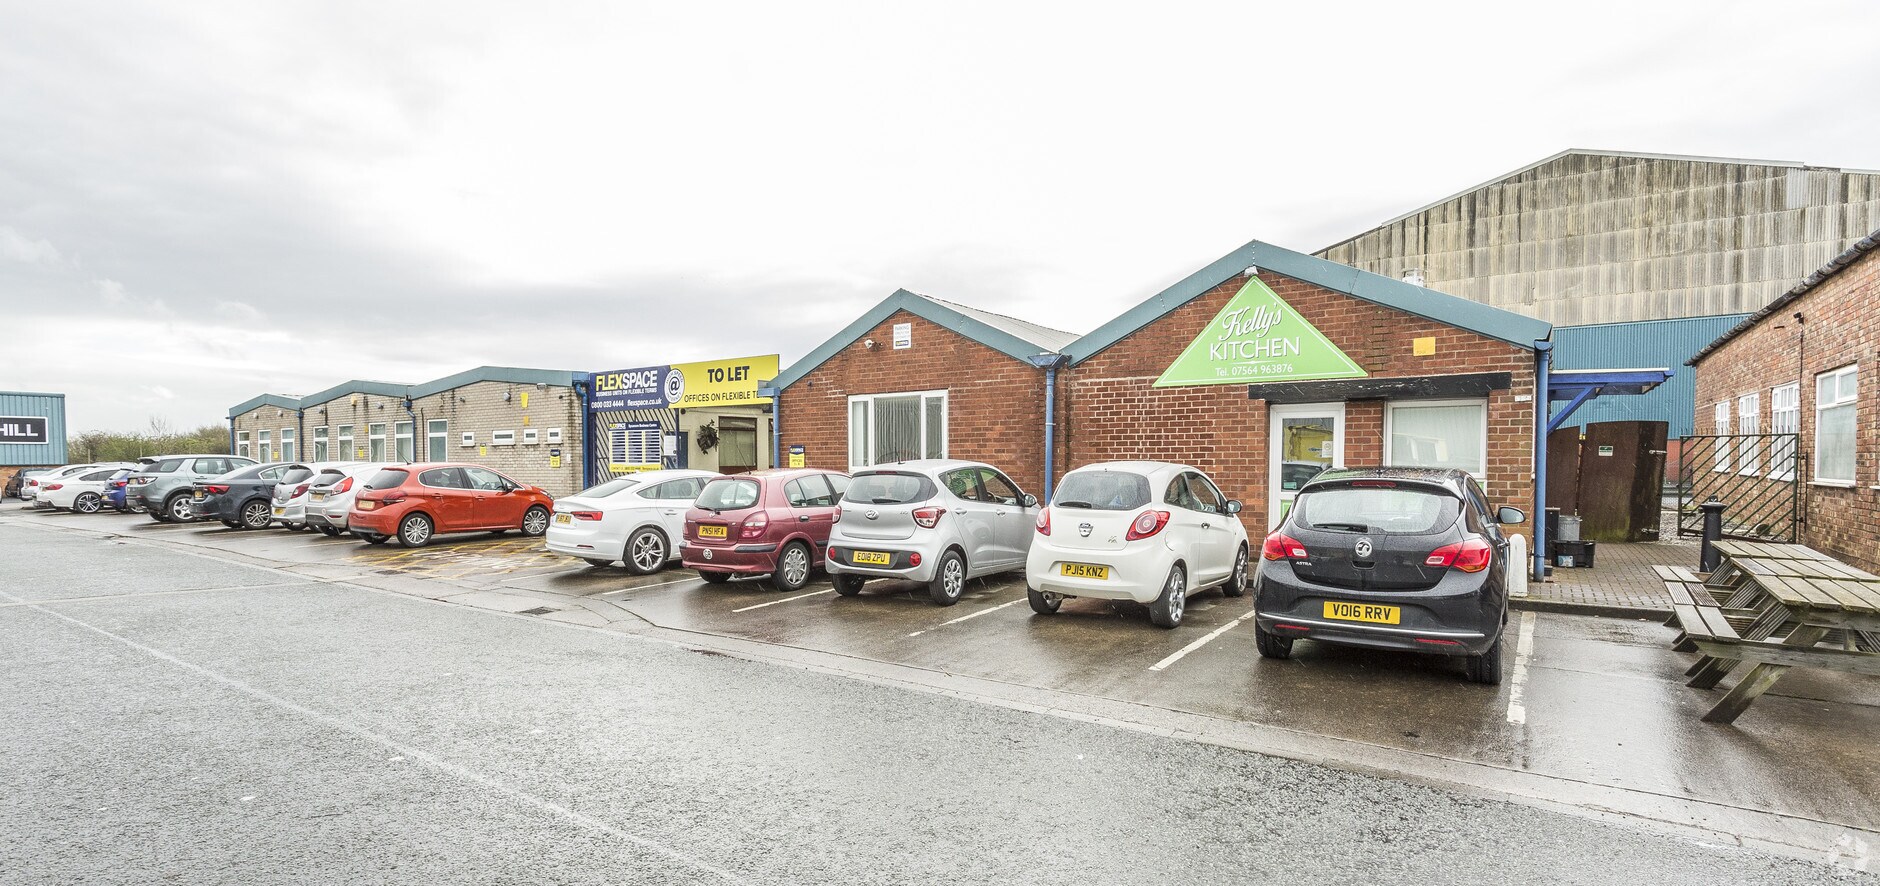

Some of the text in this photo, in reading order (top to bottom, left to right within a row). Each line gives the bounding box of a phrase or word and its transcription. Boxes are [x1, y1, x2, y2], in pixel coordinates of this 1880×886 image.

[1219, 302, 1282, 341] Kelly's
[1210, 336, 1300, 361] KITCHEN
[707, 365, 750, 384] TO LET
[1215, 363, 1293, 376] Tel. 07564 963876
[595, 370, 658, 392] FLEXSPACE
[684, 393, 709, 403] OFFICES
[710, 393, 720, 401] ON
[721, 390, 751, 401] FLEXIBLE
[872, 553, 886, 562] ZPU
[1066, 564, 1104, 578] PJ15 KNZ
[1333, 603, 1392, 621] VO16 RRV
